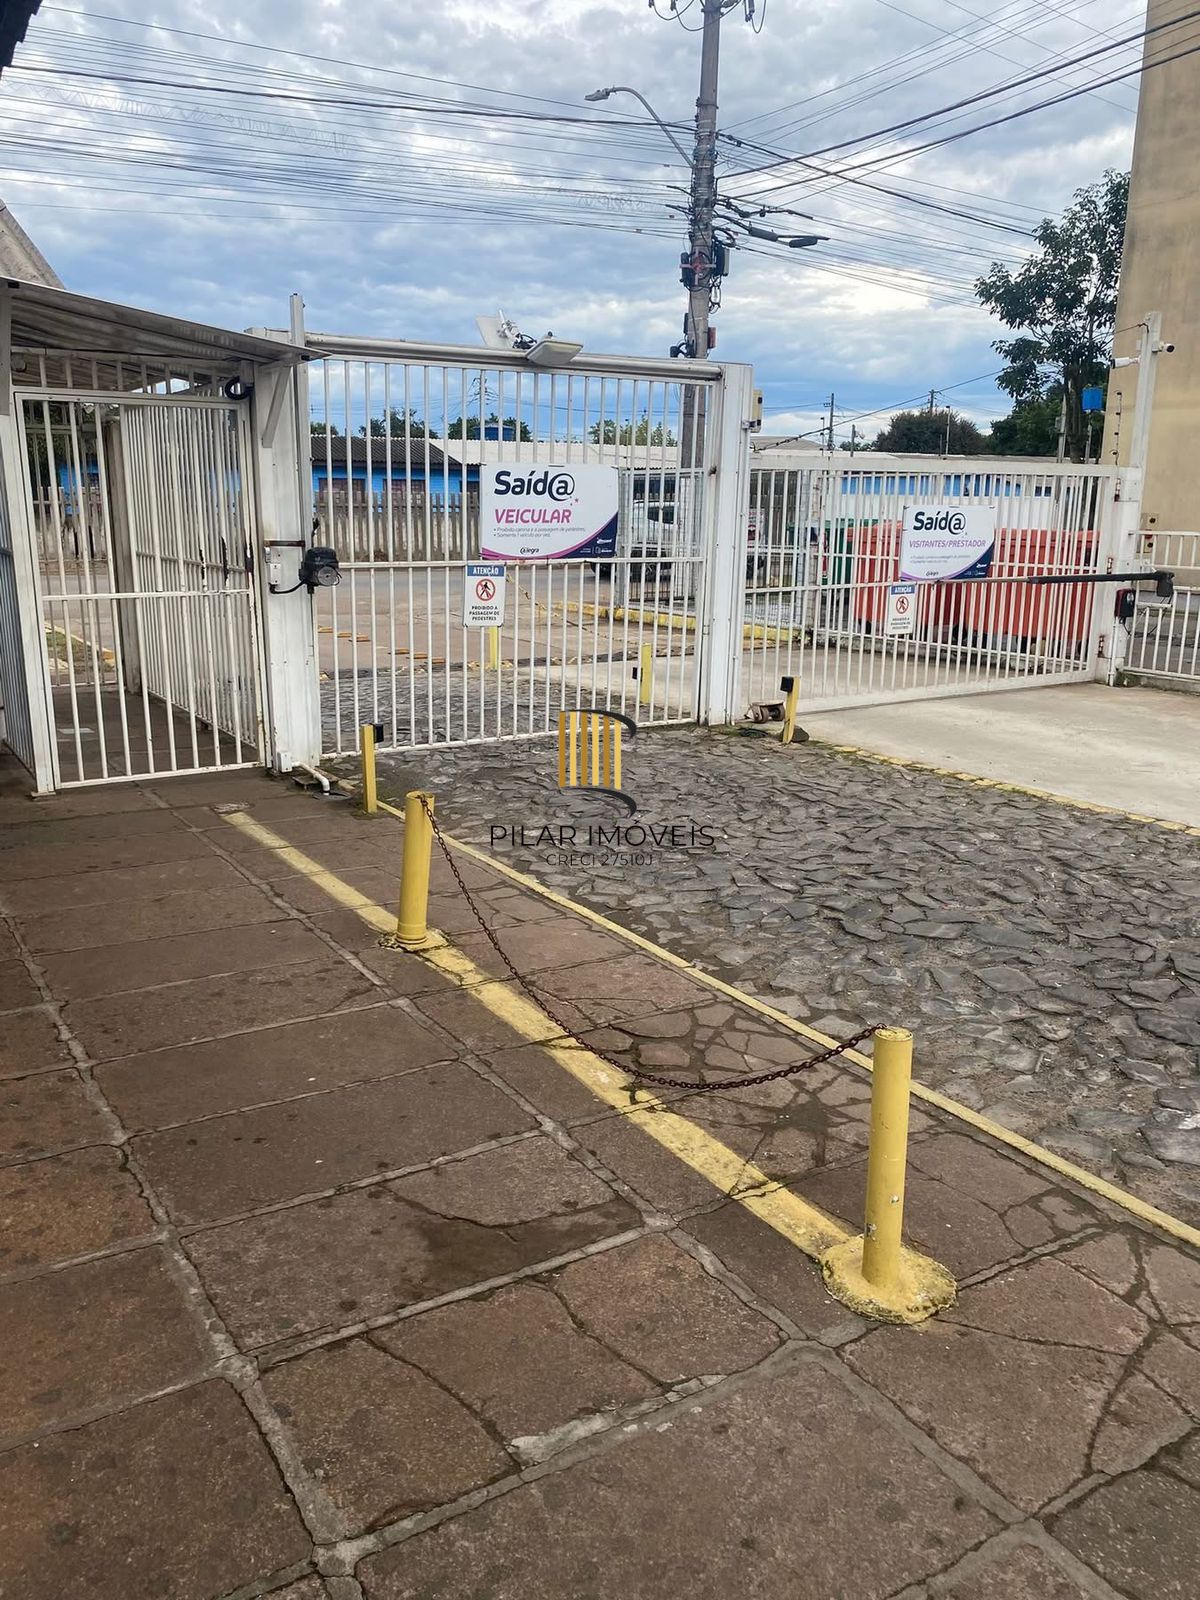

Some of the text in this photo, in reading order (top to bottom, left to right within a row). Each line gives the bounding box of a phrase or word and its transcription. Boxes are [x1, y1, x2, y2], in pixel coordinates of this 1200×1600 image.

[494, 508, 572, 524] VEICULAR
[909, 540, 986, 548] VISITANTES/PRESTADOR
[472, 565, 499, 576] ATENÇÃO
